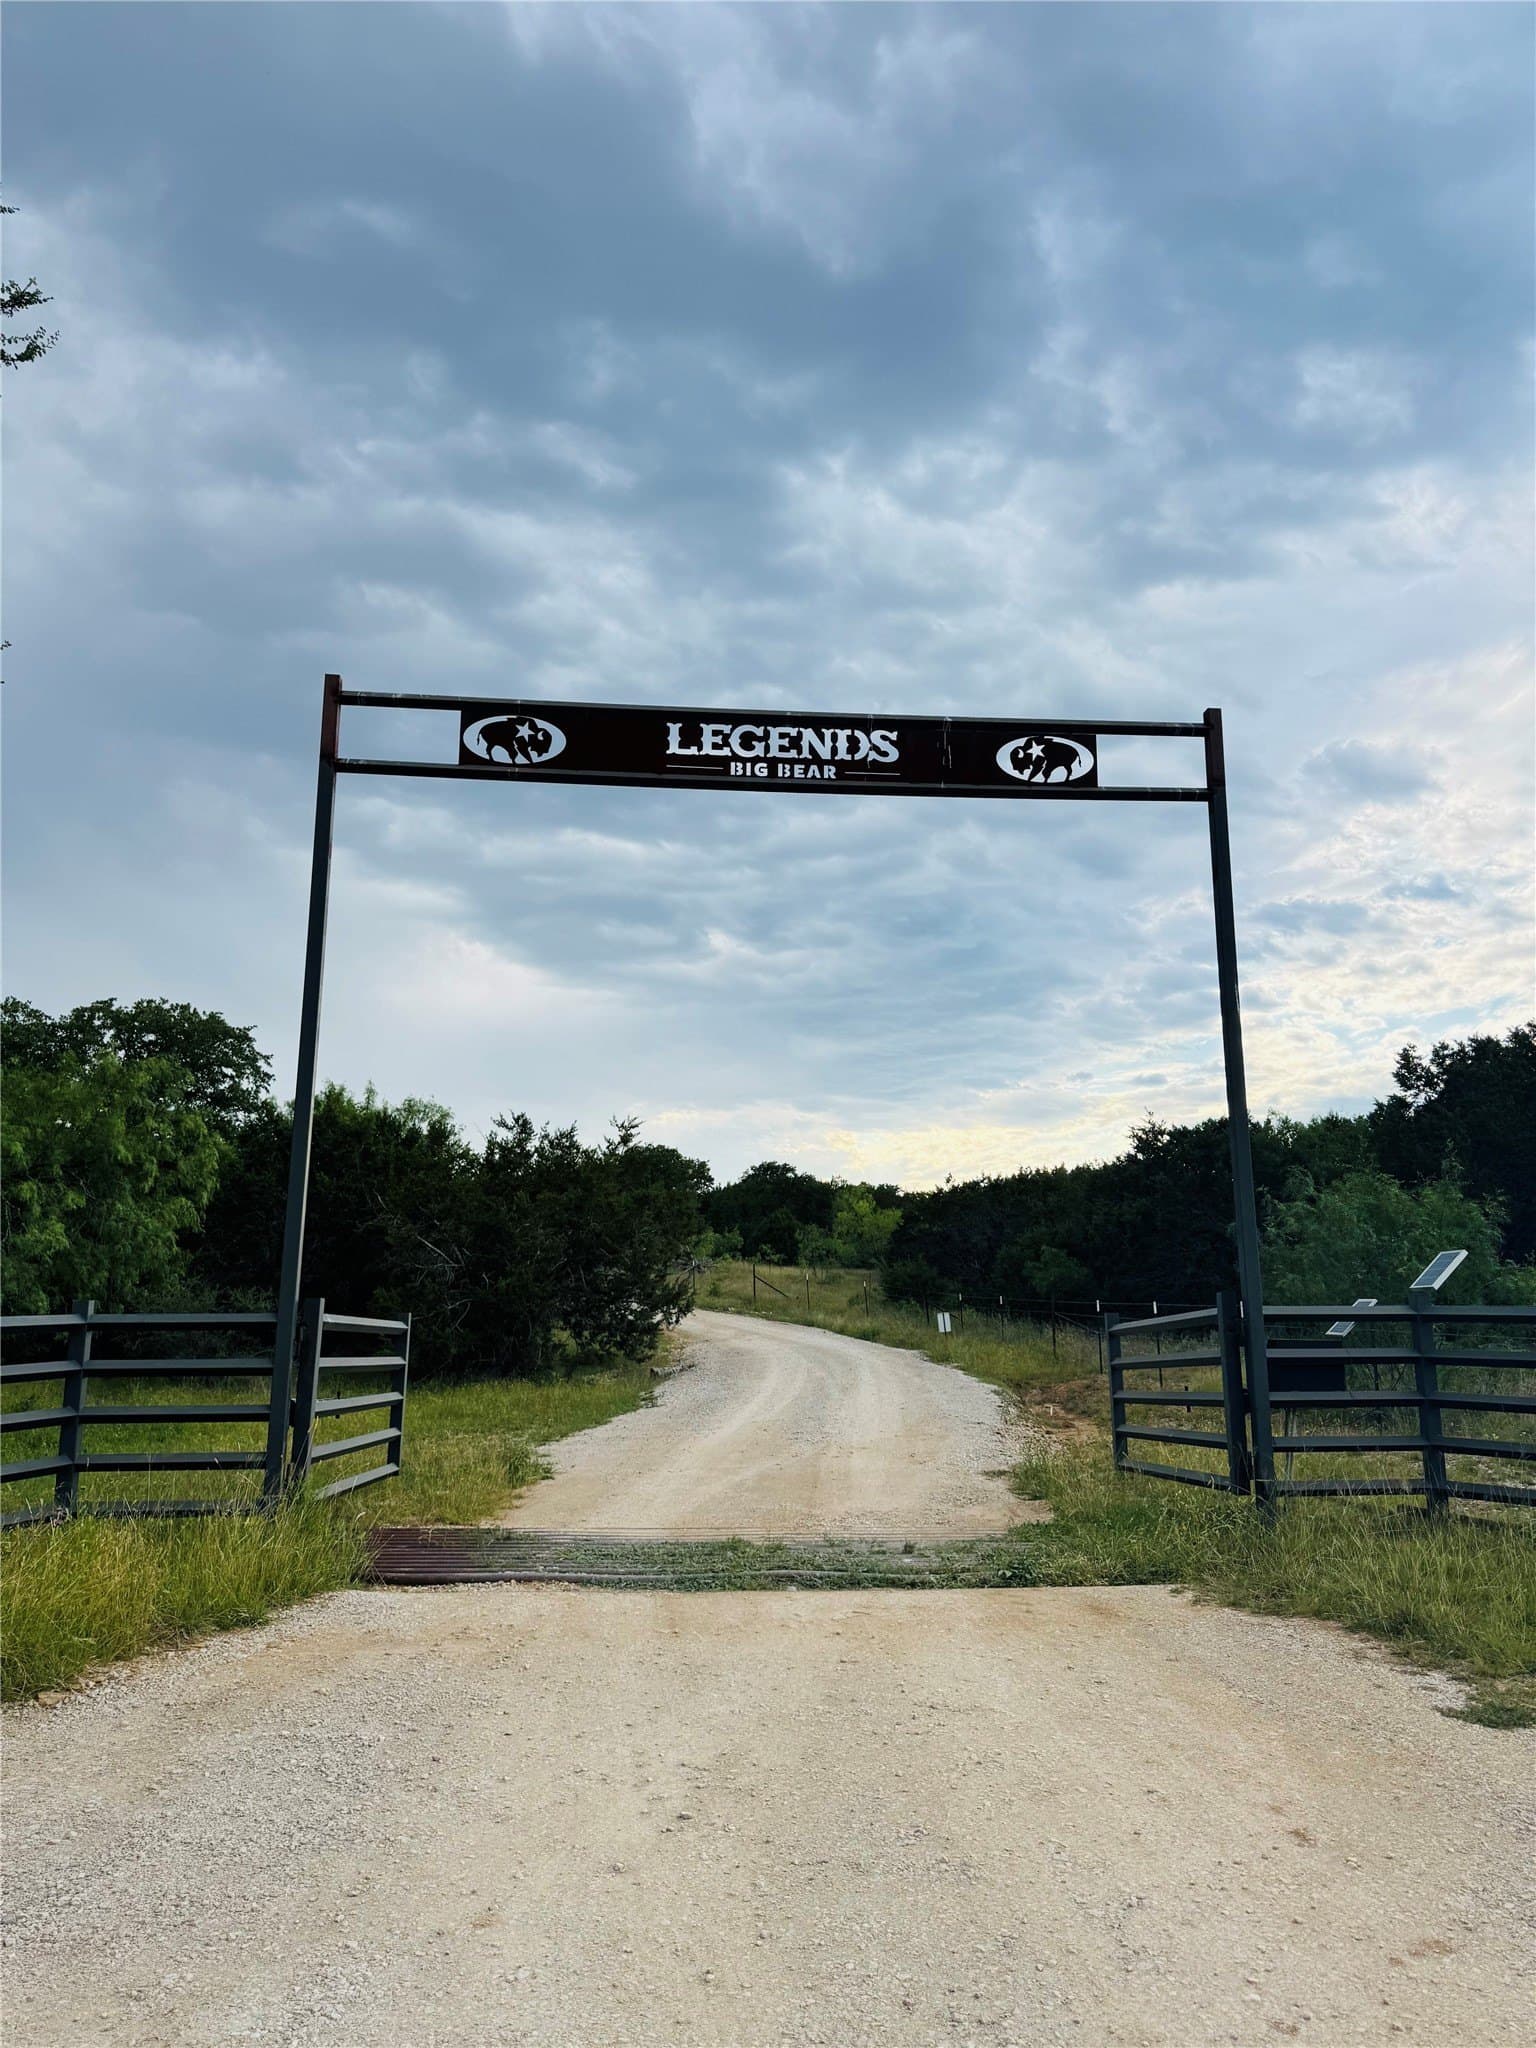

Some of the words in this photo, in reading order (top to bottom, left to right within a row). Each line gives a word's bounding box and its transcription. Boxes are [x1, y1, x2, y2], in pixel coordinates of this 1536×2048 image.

[666, 722, 900, 763] LEGENDS
[730, 761, 769, 777] BIG
[777, 762, 837, 779] BEAR
